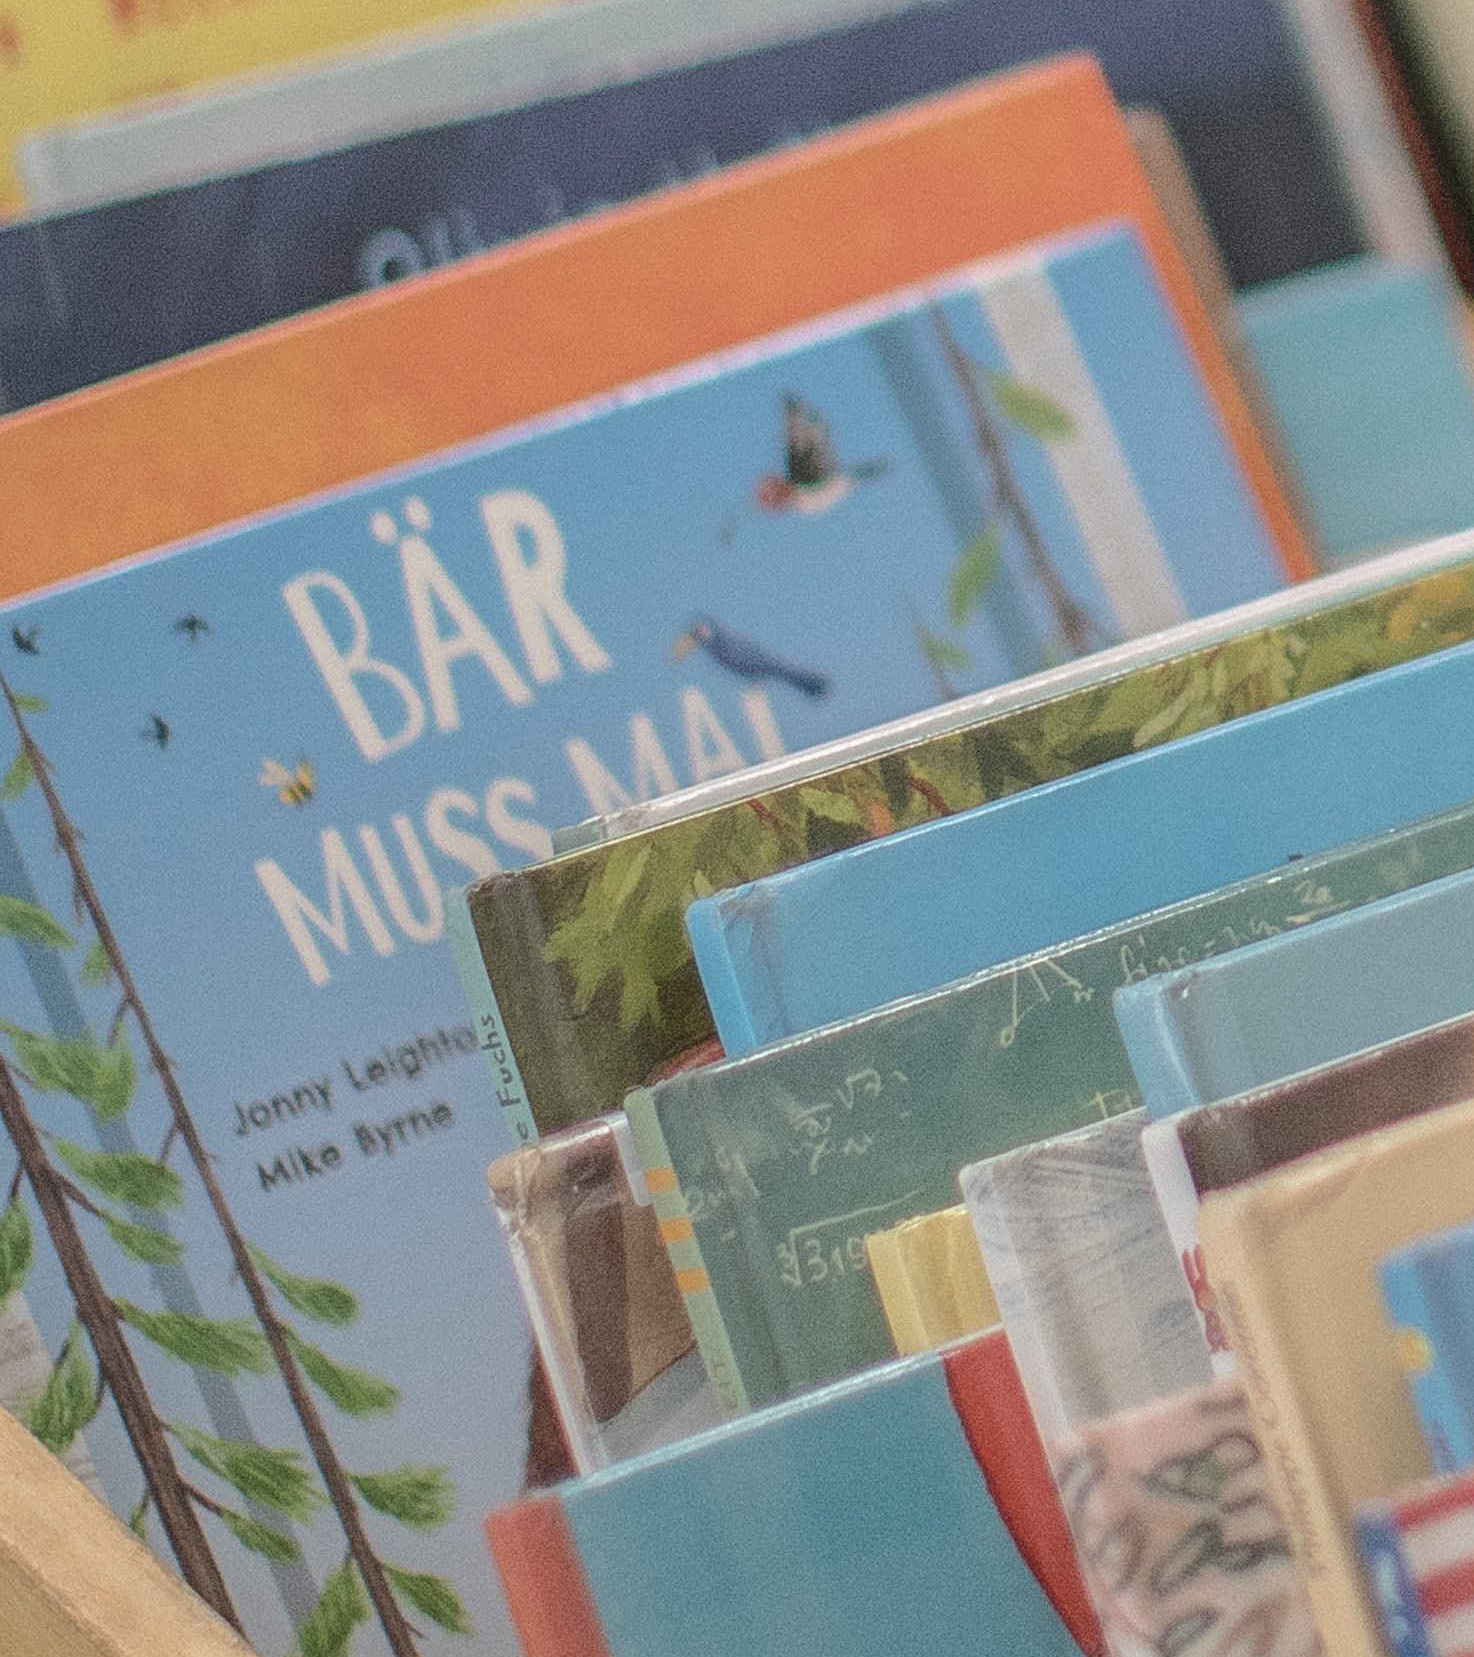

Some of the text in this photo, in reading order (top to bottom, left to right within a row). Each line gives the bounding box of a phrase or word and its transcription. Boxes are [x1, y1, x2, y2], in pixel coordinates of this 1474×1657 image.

[281, 490, 611, 763] BÄR
[254, 777, 553, 987] MUSS
[233, 1077, 333, 1137] Jonny
[480, 1012, 522, 1109] Fuchs
[256, 1099, 455, 1192] Mike Byrne
